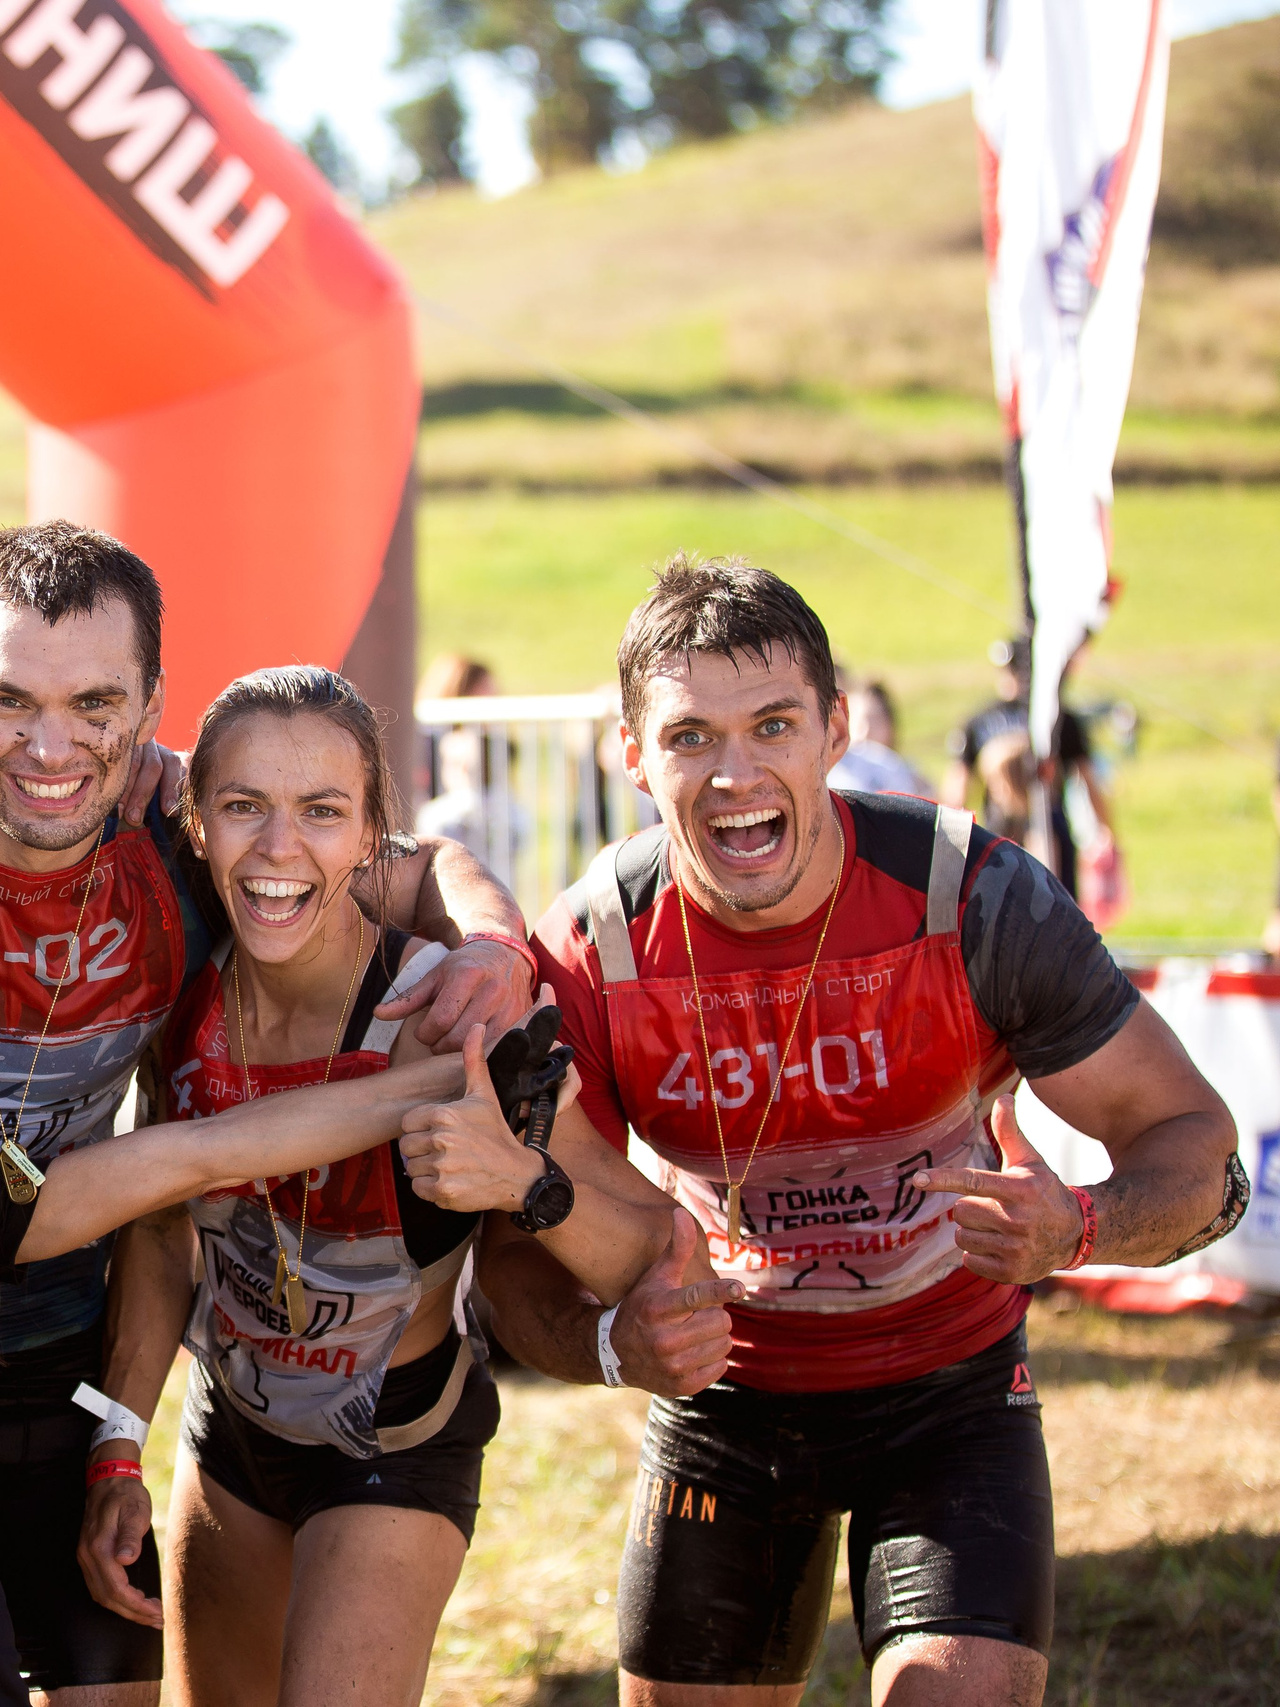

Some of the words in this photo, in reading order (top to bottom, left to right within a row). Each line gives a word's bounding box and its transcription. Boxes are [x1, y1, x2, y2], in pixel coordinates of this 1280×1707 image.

[59, 862, 116, 898] старт
[681, 974, 816, 1013] Командный
[825, 968, 896, 996] старт
[657, 1029, 890, 1111] 431-01
[767, 1185, 870, 1213] ГОНКА
